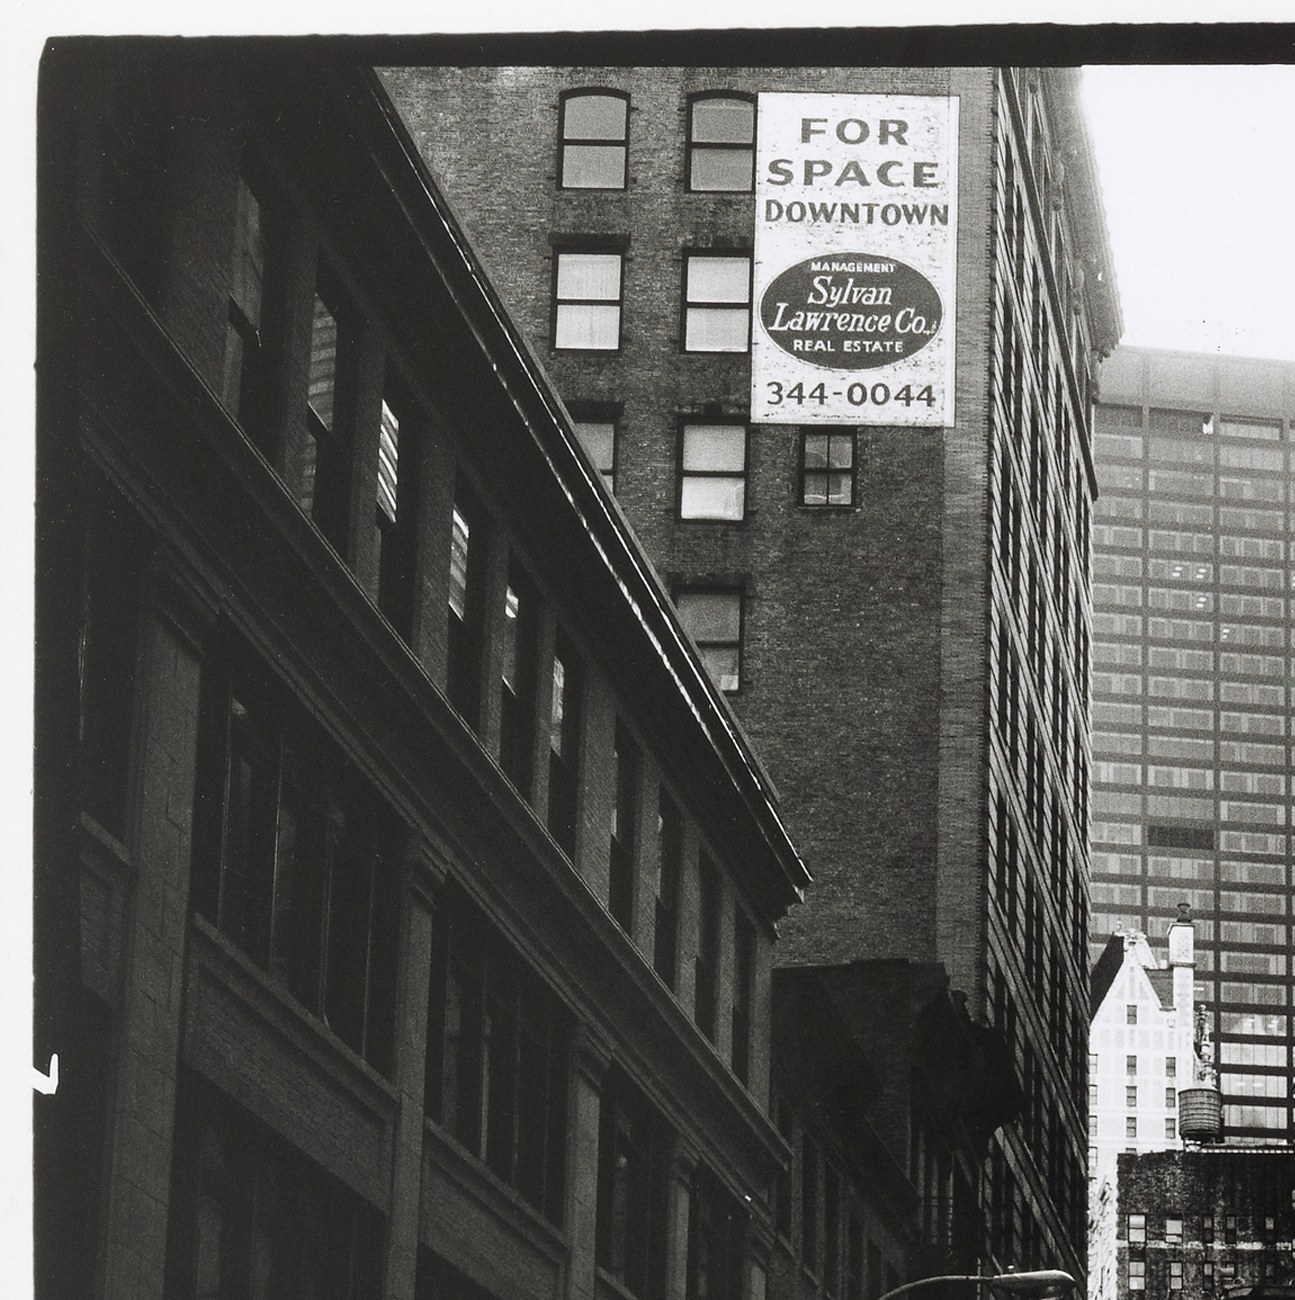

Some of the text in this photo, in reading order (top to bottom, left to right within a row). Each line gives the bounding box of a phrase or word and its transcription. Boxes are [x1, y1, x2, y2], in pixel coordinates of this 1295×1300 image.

[800, 118, 909, 146] FOR
[766, 159, 940, 188] SPACE
[765, 200, 949, 226] DOWNTOWN
[811, 261, 896, 273] MANAGEMENT
[807, 275, 892, 307] Sylvan
[768, 302, 890, 333] Lawrence
[793, 339, 904, 353] REAL ESTATE
[766, 382, 936, 407] 344-0044
